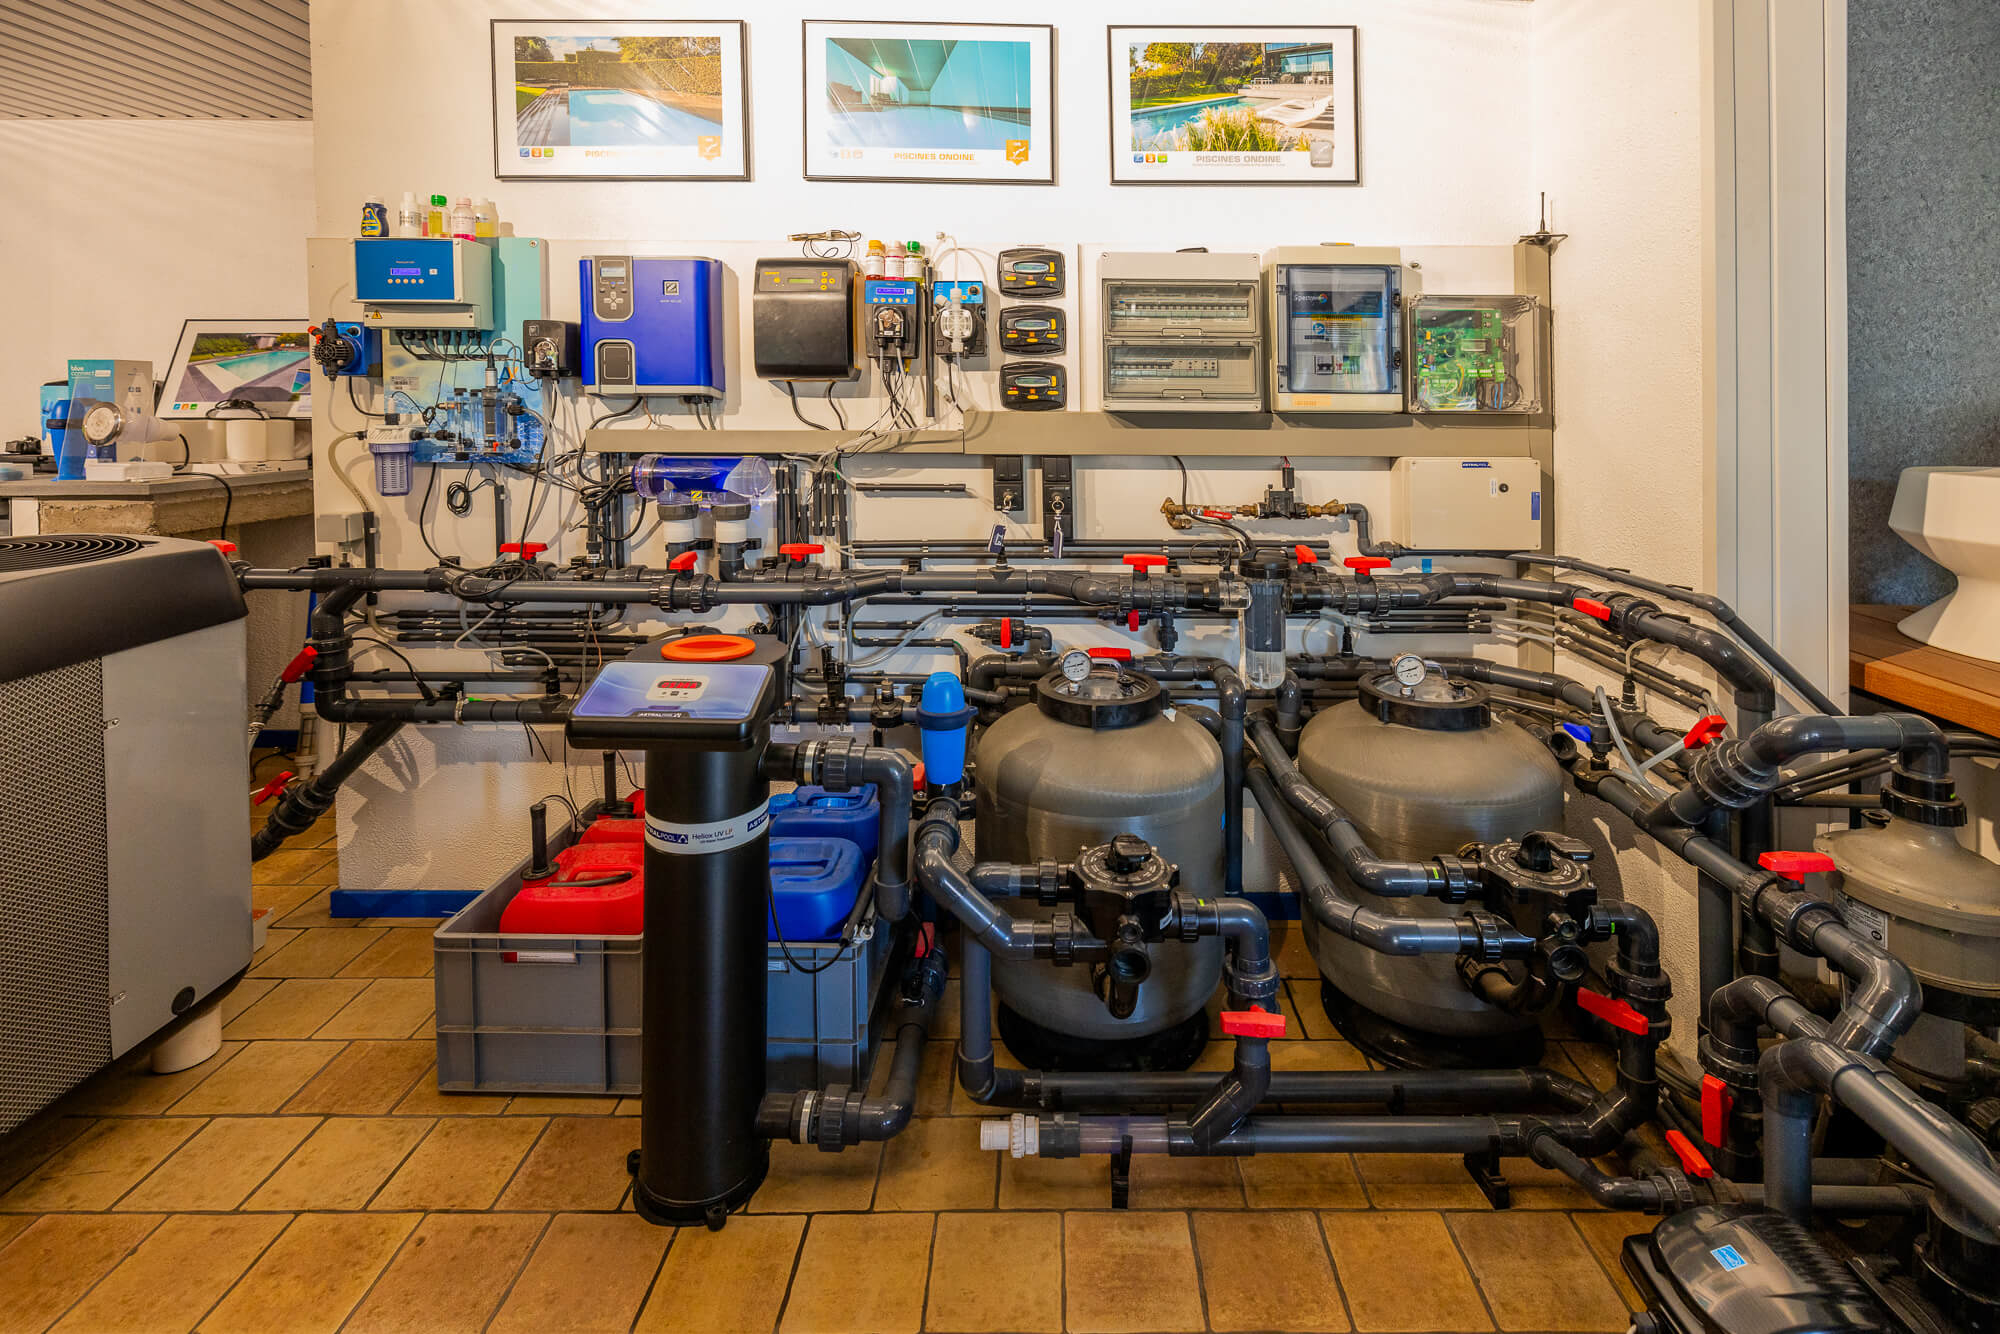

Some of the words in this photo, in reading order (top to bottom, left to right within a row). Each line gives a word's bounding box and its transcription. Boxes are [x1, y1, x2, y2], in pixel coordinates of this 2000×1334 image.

[893, 152, 936, 161] PISCINES
[939, 153, 975, 161] ONDINE
[1196, 155, 1241, 163] PISCINES
[1244, 155, 1281, 163] ONDINE
[692, 832, 713, 840] Heliox
[714, 830, 725, 838] UV
